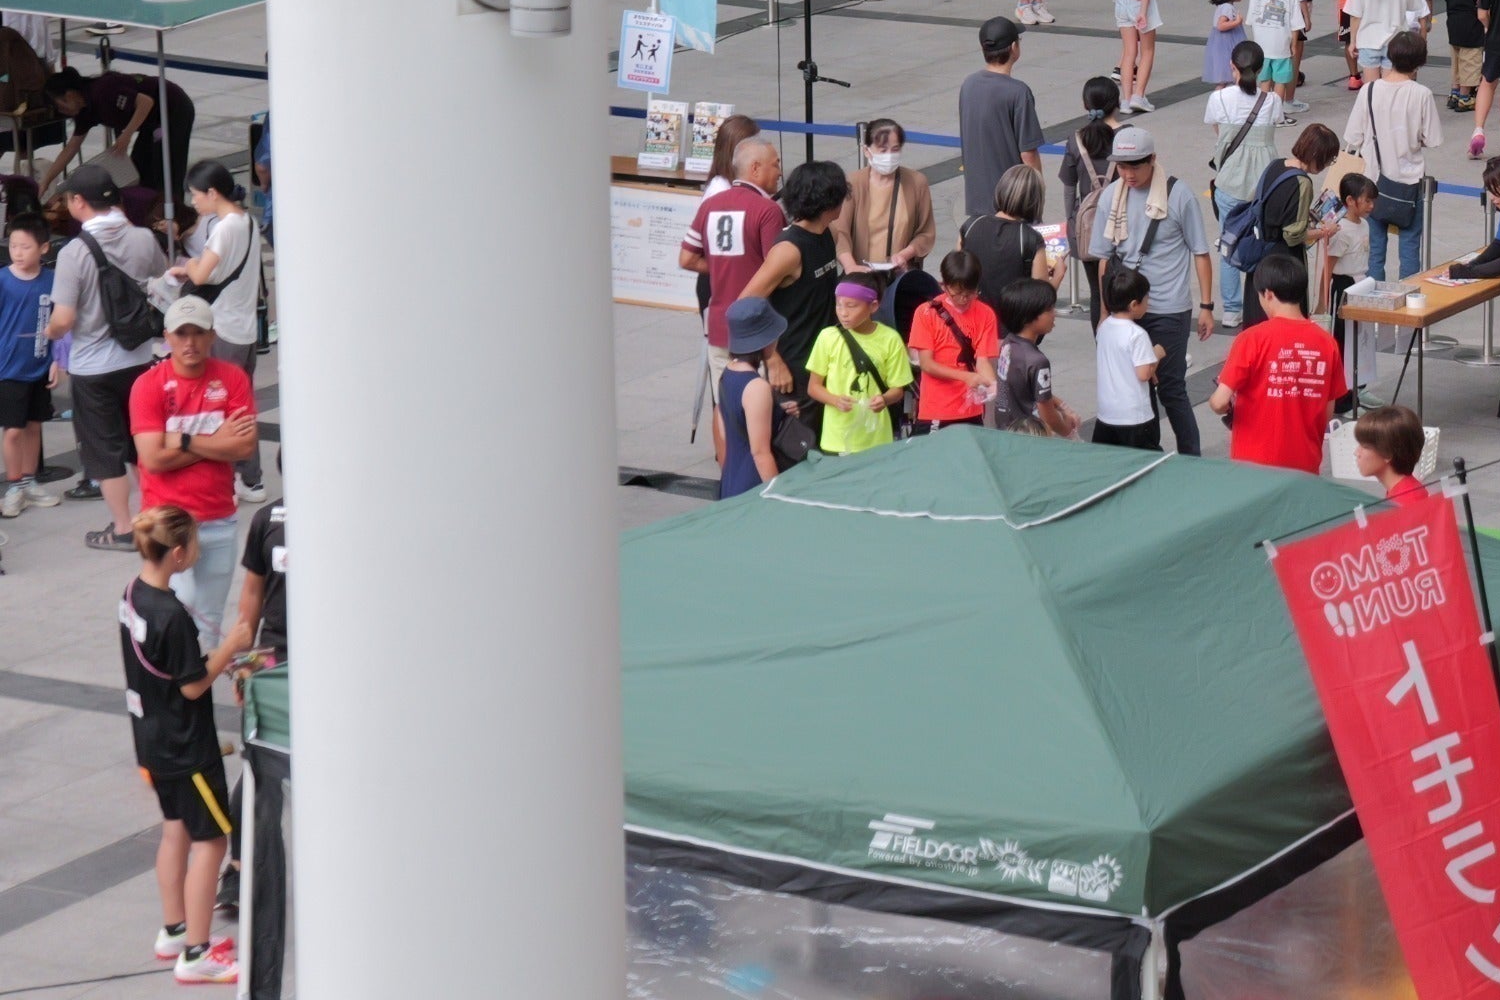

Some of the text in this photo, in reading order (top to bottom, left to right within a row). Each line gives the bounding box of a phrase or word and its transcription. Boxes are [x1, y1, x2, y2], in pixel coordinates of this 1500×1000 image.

[717, 214, 734, 252] 8
[868, 848, 905, 864] Powered
[909, 855, 921, 867] by
[893, 834, 979, 865] FIELDOOR
